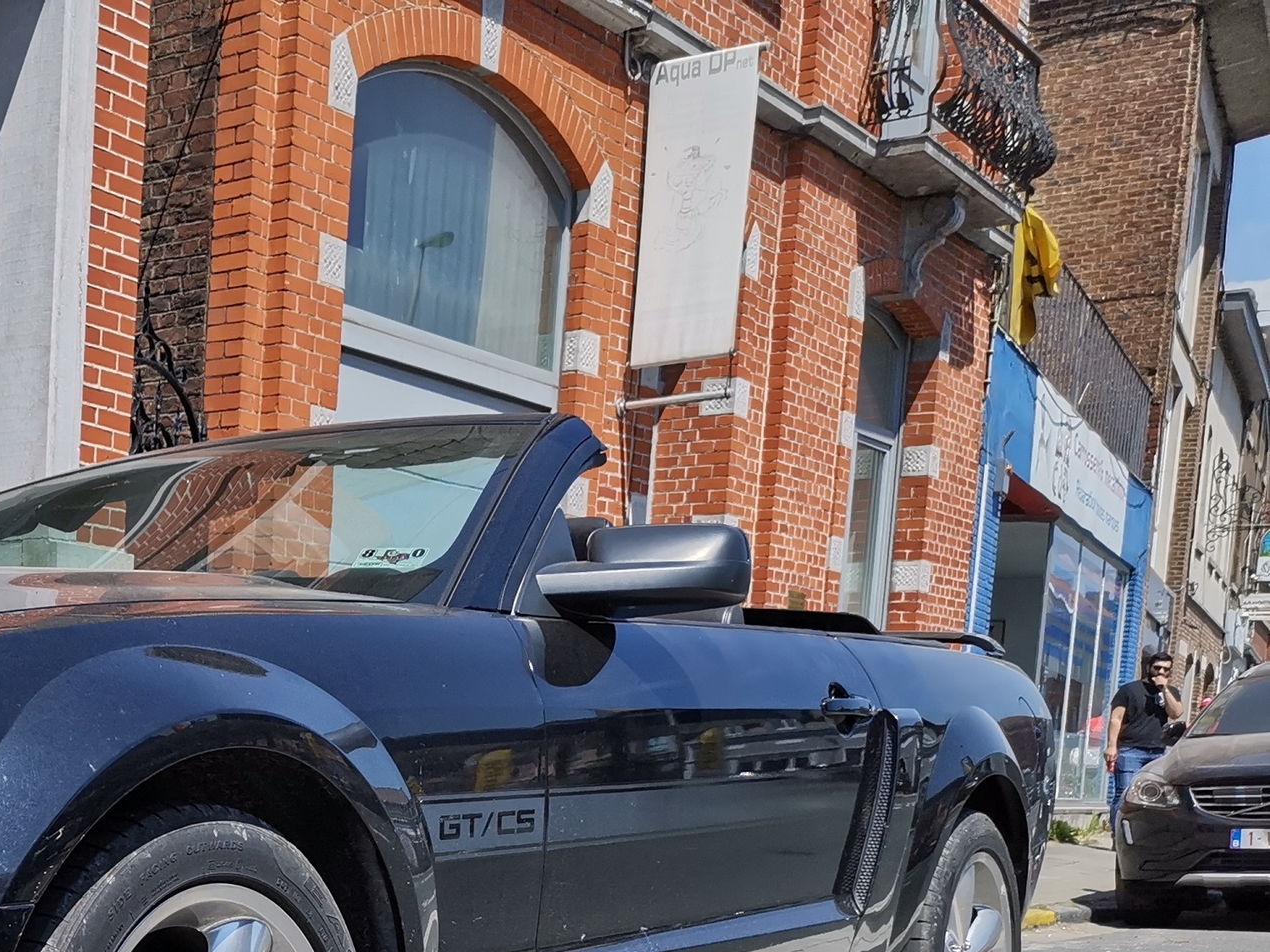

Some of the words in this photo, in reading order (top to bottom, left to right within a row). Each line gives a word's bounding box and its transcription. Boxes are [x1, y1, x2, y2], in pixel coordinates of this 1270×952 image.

[655, 59, 701, 87] Aqua
[439, 809, 536, 841] GT/CS
[107, 886, 132, 922] SIDE
